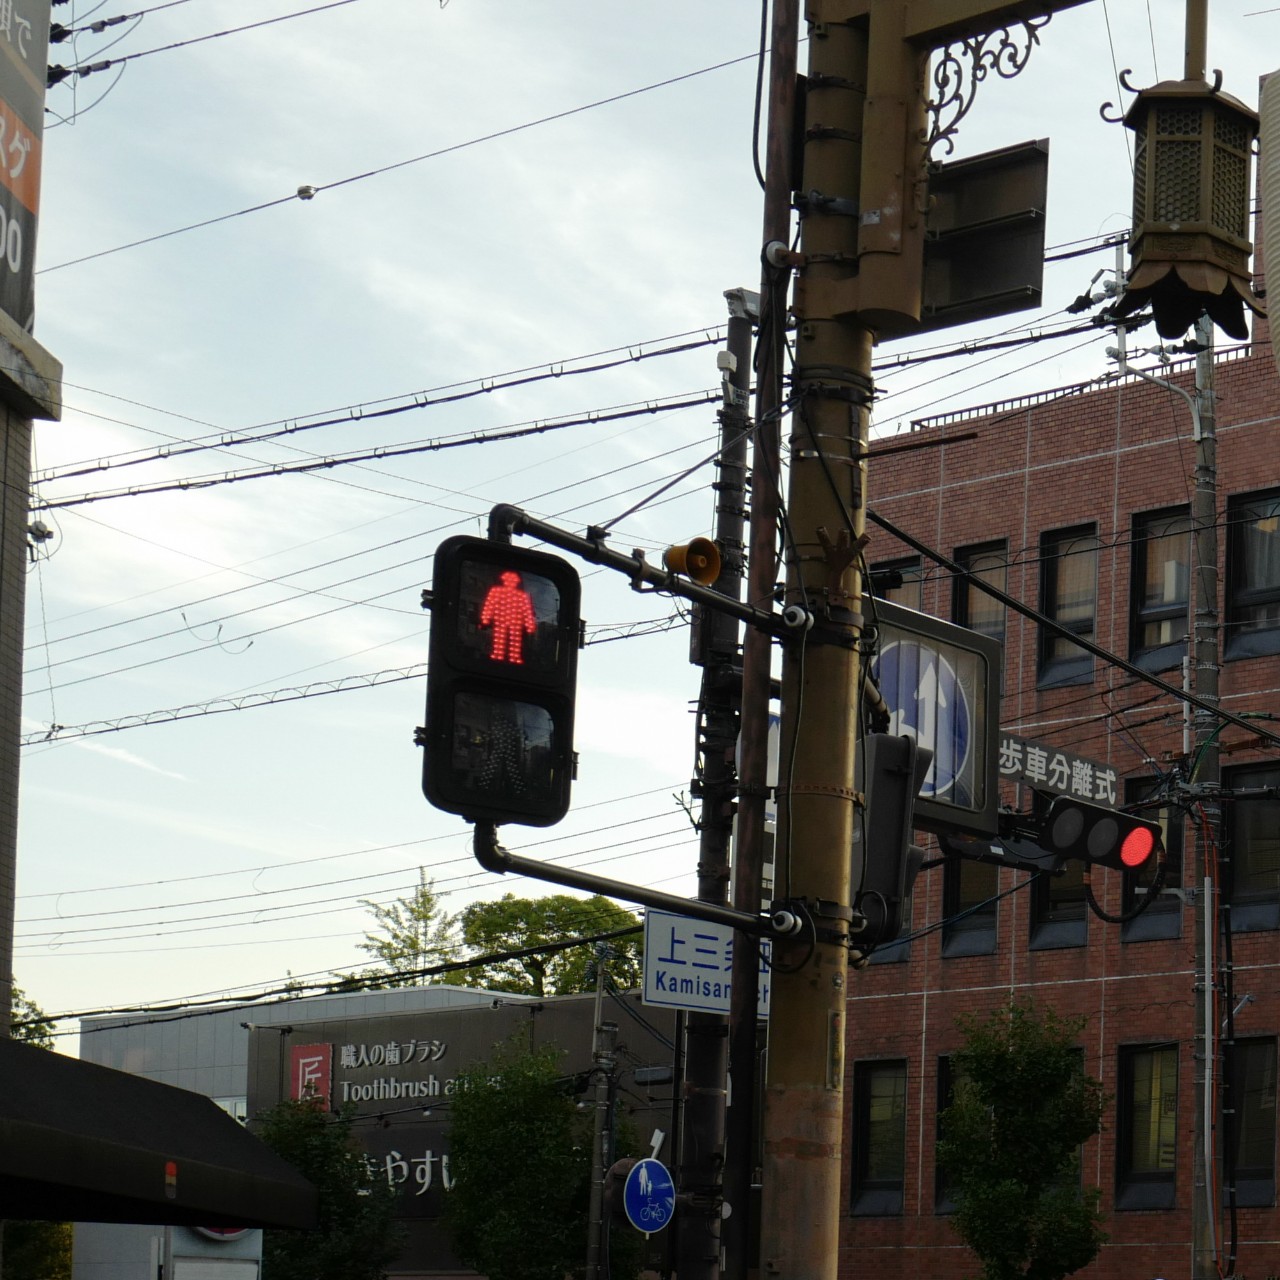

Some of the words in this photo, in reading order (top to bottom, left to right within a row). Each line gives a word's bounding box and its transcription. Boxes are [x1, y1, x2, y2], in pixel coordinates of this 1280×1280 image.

[1000, 738, 1117, 806] 歩車分離式
[340, 1039, 447, 1069] 職人の歯ブラシ
[340, 1074, 440, 1102] Toothbrush
